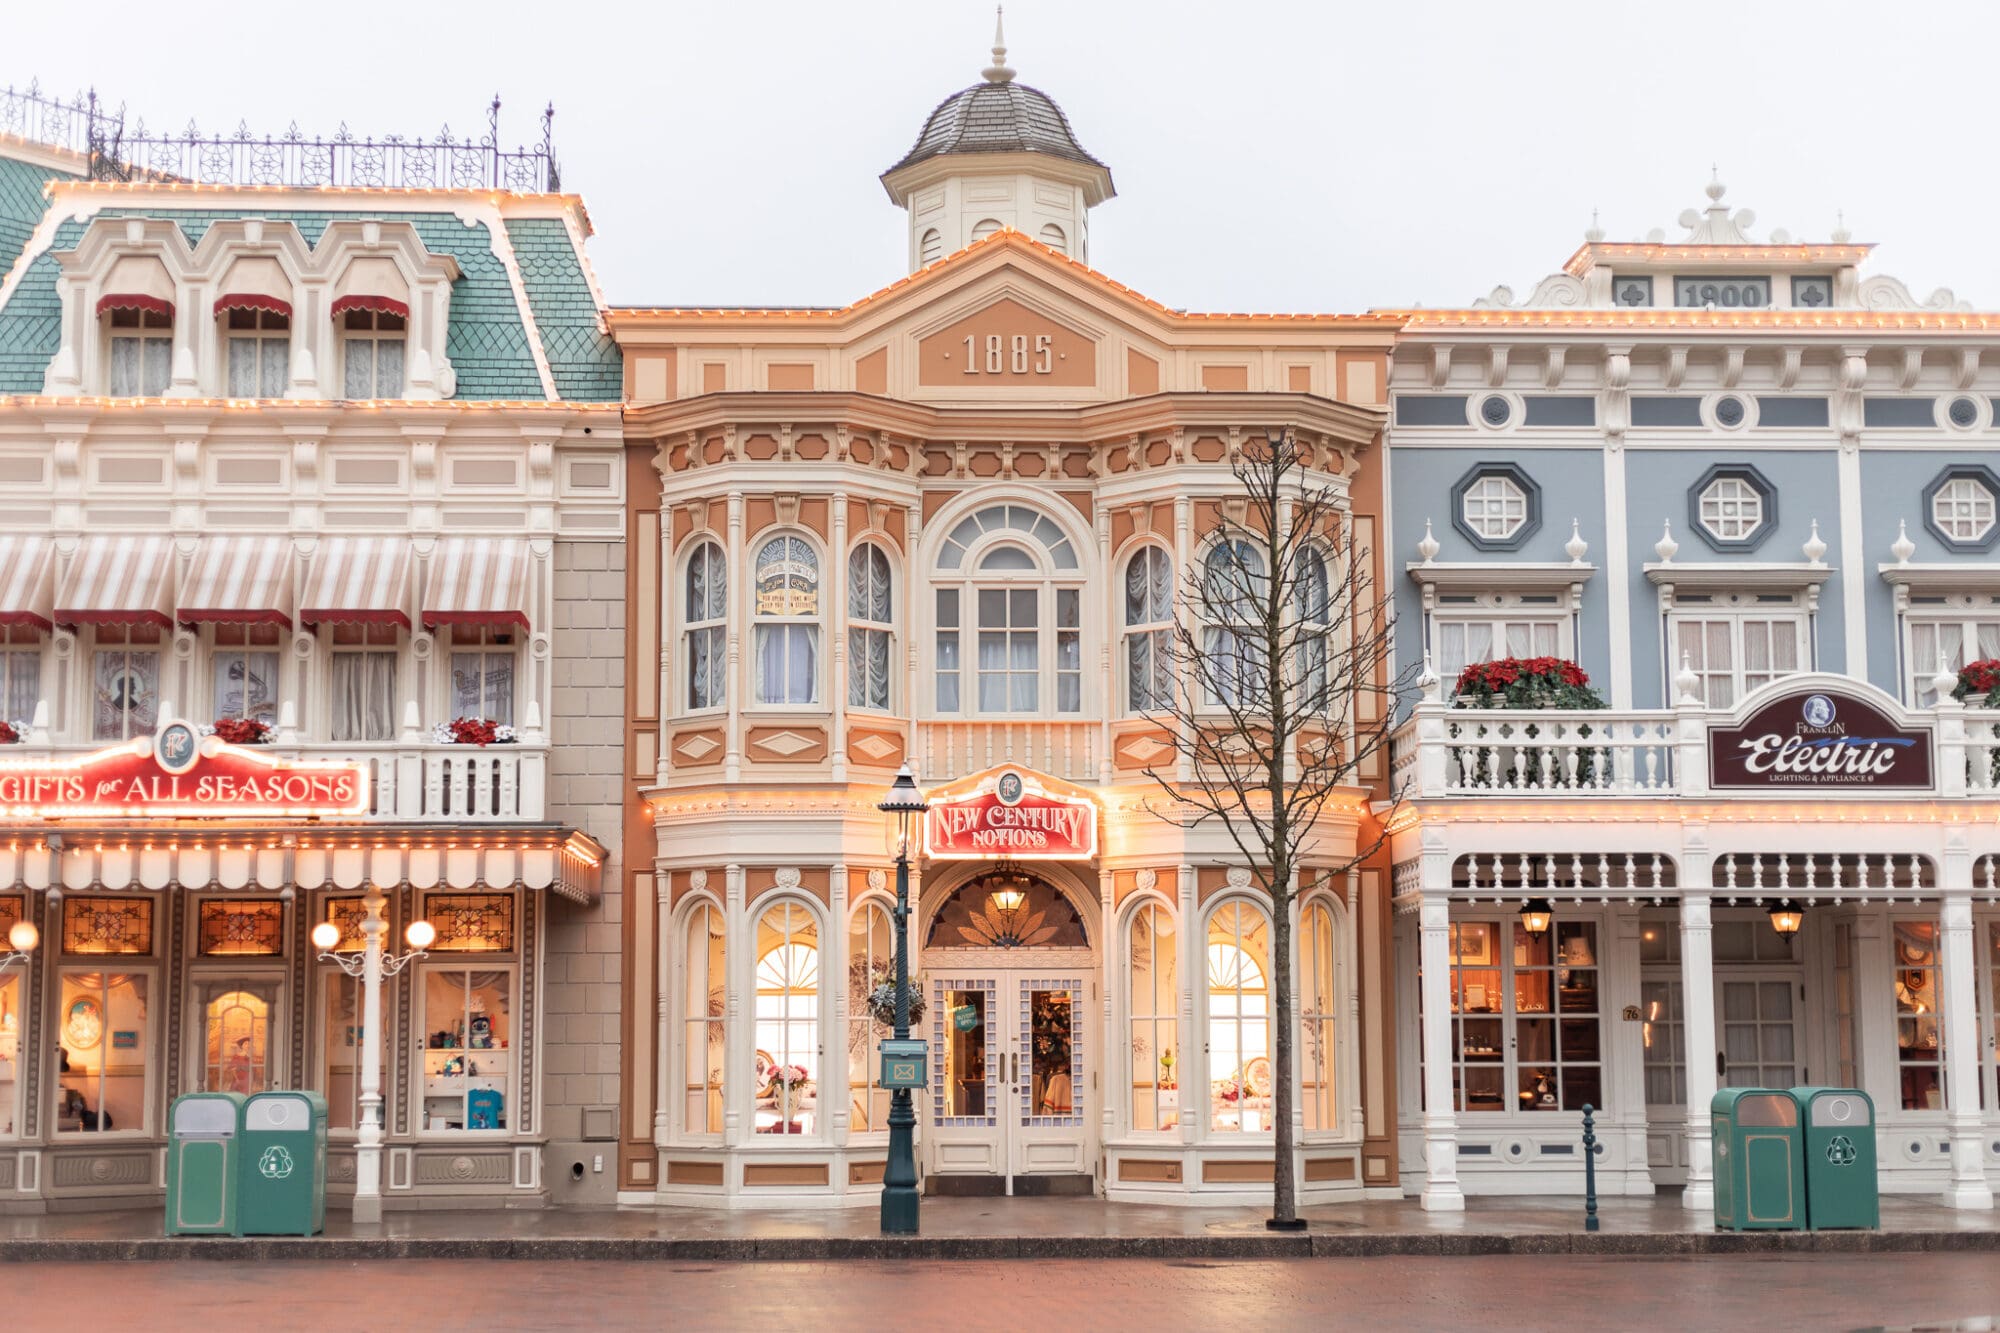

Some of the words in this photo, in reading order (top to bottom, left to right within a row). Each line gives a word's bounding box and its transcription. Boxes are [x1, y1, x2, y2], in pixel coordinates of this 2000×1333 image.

[1684, 284, 1761, 306] 1900
[962, 334, 1052, 375] 1885
[1796, 721, 1845, 735] FRANKLIN
[1738, 734, 1896, 774] Electric
[1769, 774, 1811, 782] LIGHTING
[1821, 774, 1866, 782] APPLIANCE
[0, 775, 86, 802] GIFTS
[93, 779, 123, 804] for
[125, 775, 191, 802] ALL
[195, 775, 353, 802] SEASONS
[934, 806, 983, 849] NEW
[986, 805, 1087, 849] CENTURY
[971, 828, 1048, 848] NOTIONS
[1626, 1008, 1639, 1020] 76
